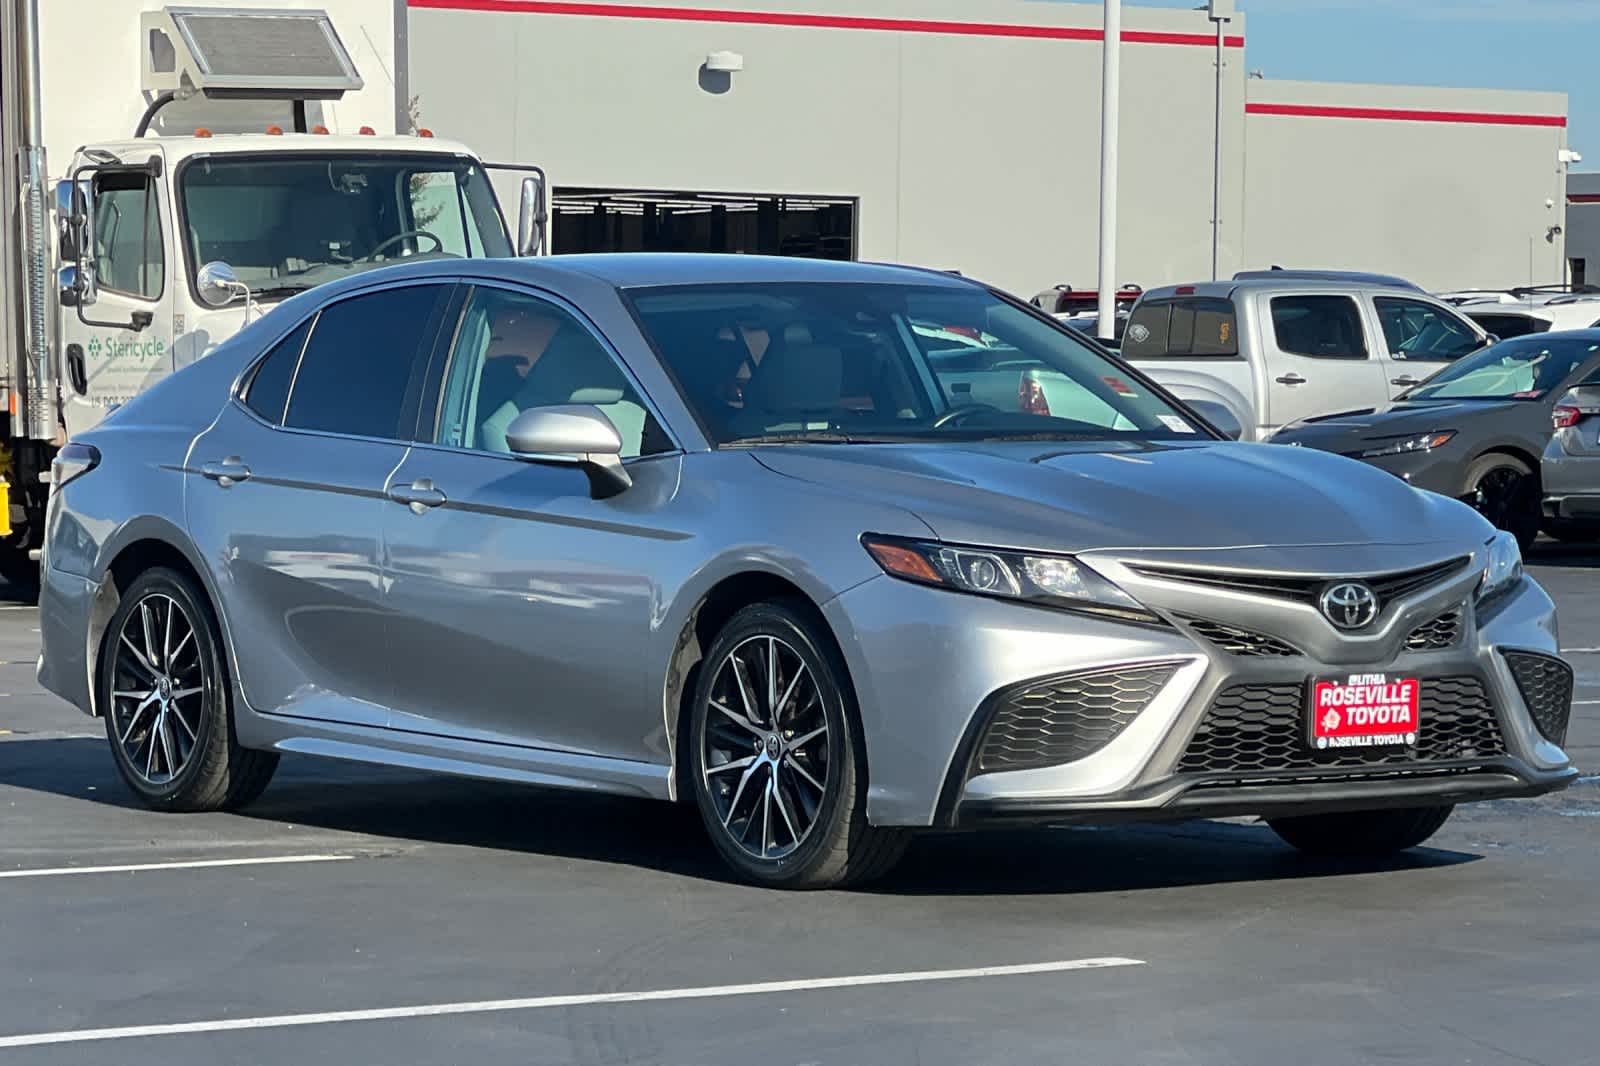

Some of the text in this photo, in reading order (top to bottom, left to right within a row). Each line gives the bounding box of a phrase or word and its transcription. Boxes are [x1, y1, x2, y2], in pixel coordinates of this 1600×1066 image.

[106, 336, 164, 361] Stericycle
[1320, 685, 1411, 706] ROSEVILLE
[1346, 705, 1410, 725] TOYOTA
[1328, 734, 1404, 747] ROSEVILLE TOYOTA
